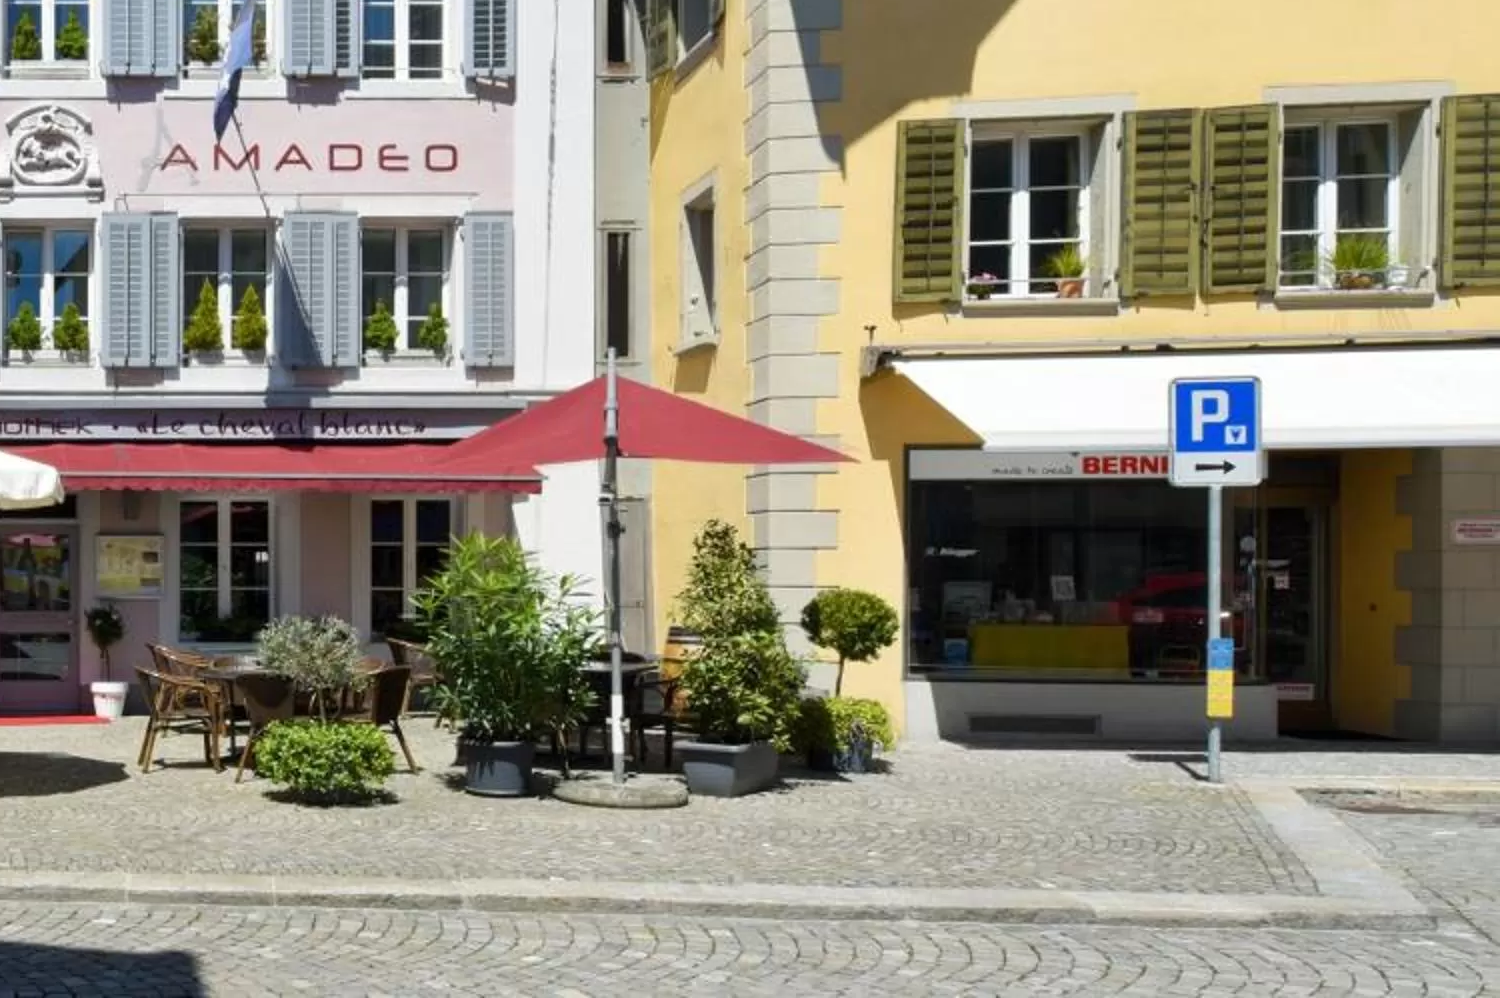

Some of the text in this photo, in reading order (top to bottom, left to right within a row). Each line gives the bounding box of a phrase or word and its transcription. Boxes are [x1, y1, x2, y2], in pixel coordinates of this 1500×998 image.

[159, 142, 460, 173] AMADEO
[198, 412, 305, 436] cheval
[1190, 388, 1231, 442] P
[1081, 455, 1169, 475] BERNI
